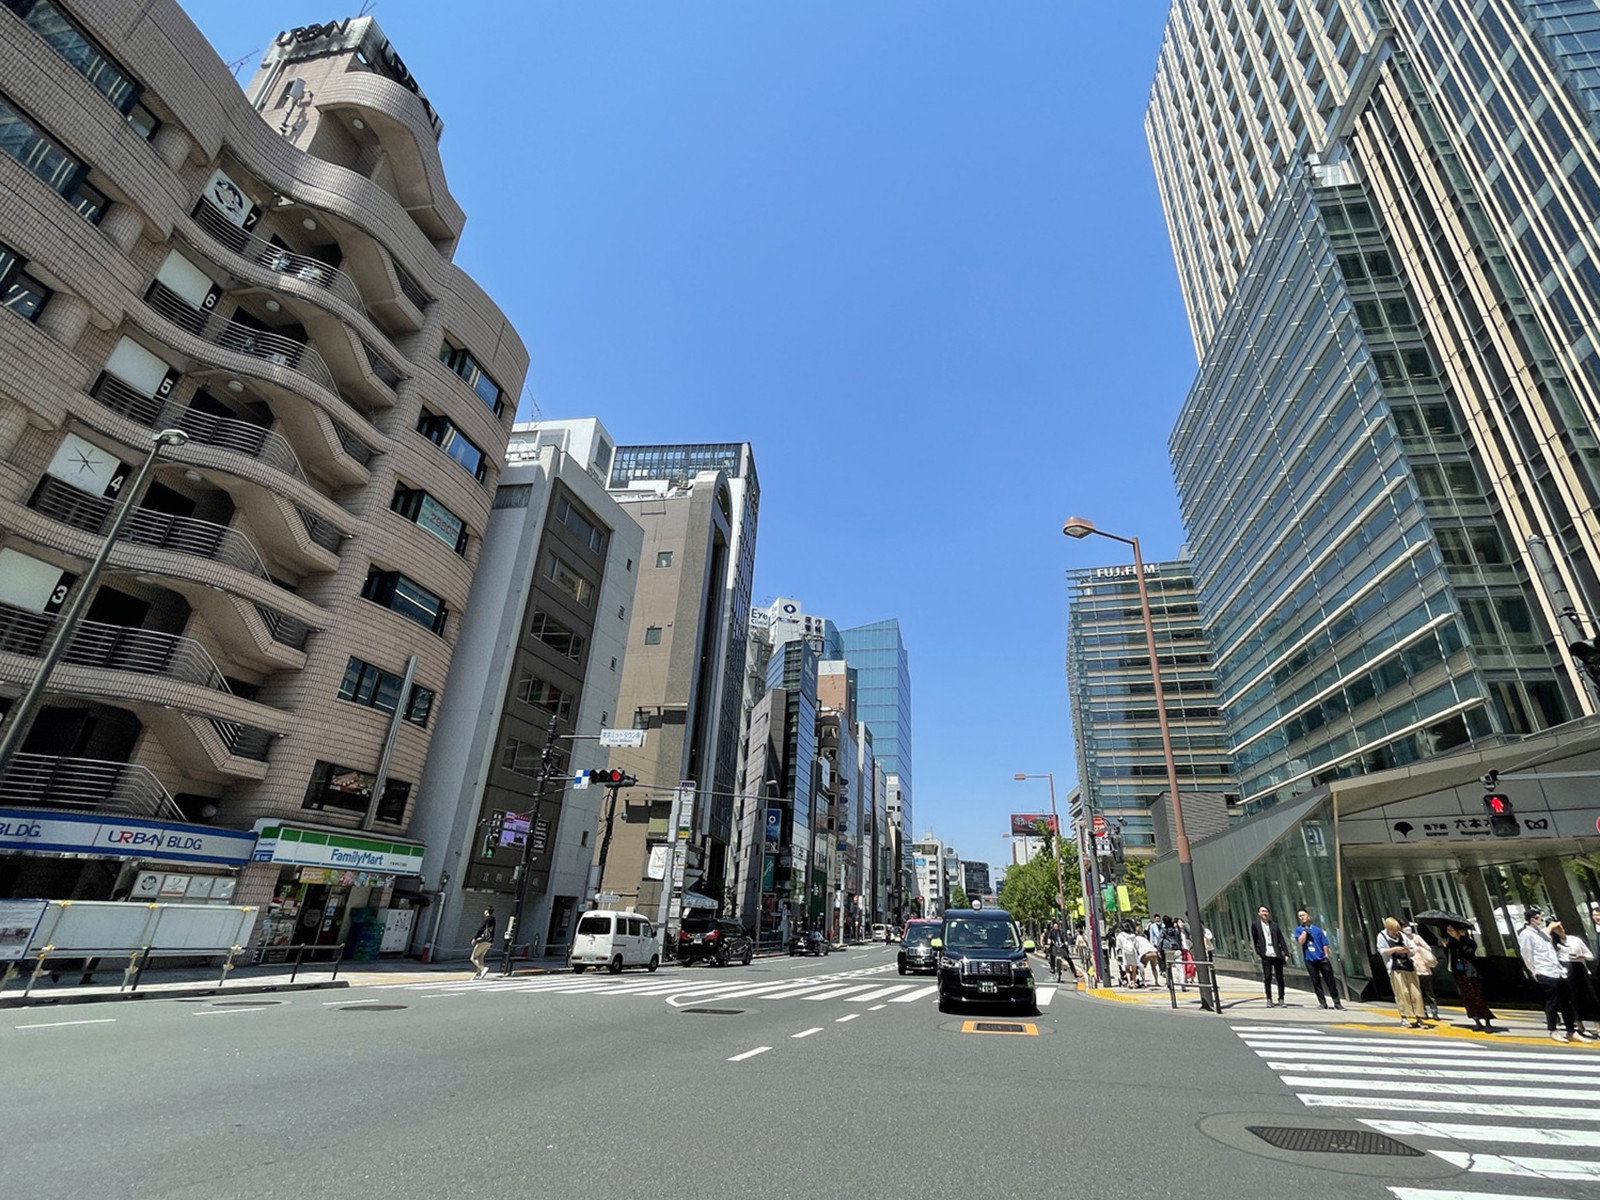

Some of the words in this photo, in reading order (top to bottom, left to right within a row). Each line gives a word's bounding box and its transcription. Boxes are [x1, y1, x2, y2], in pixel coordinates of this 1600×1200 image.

[247, 213, 258, 226] 7
[205, 293, 217, 308] 6
[160, 378, 173, 394] 5
[110, 475, 124, 492] 4
[1097, 564, 1155, 577] FUJIFIM
[51, 585, 68, 604] 3
[751, 608, 769, 621] Eye
[108, 830, 164, 847] URBAN
[330, 848, 384, 867] FamilyMart
